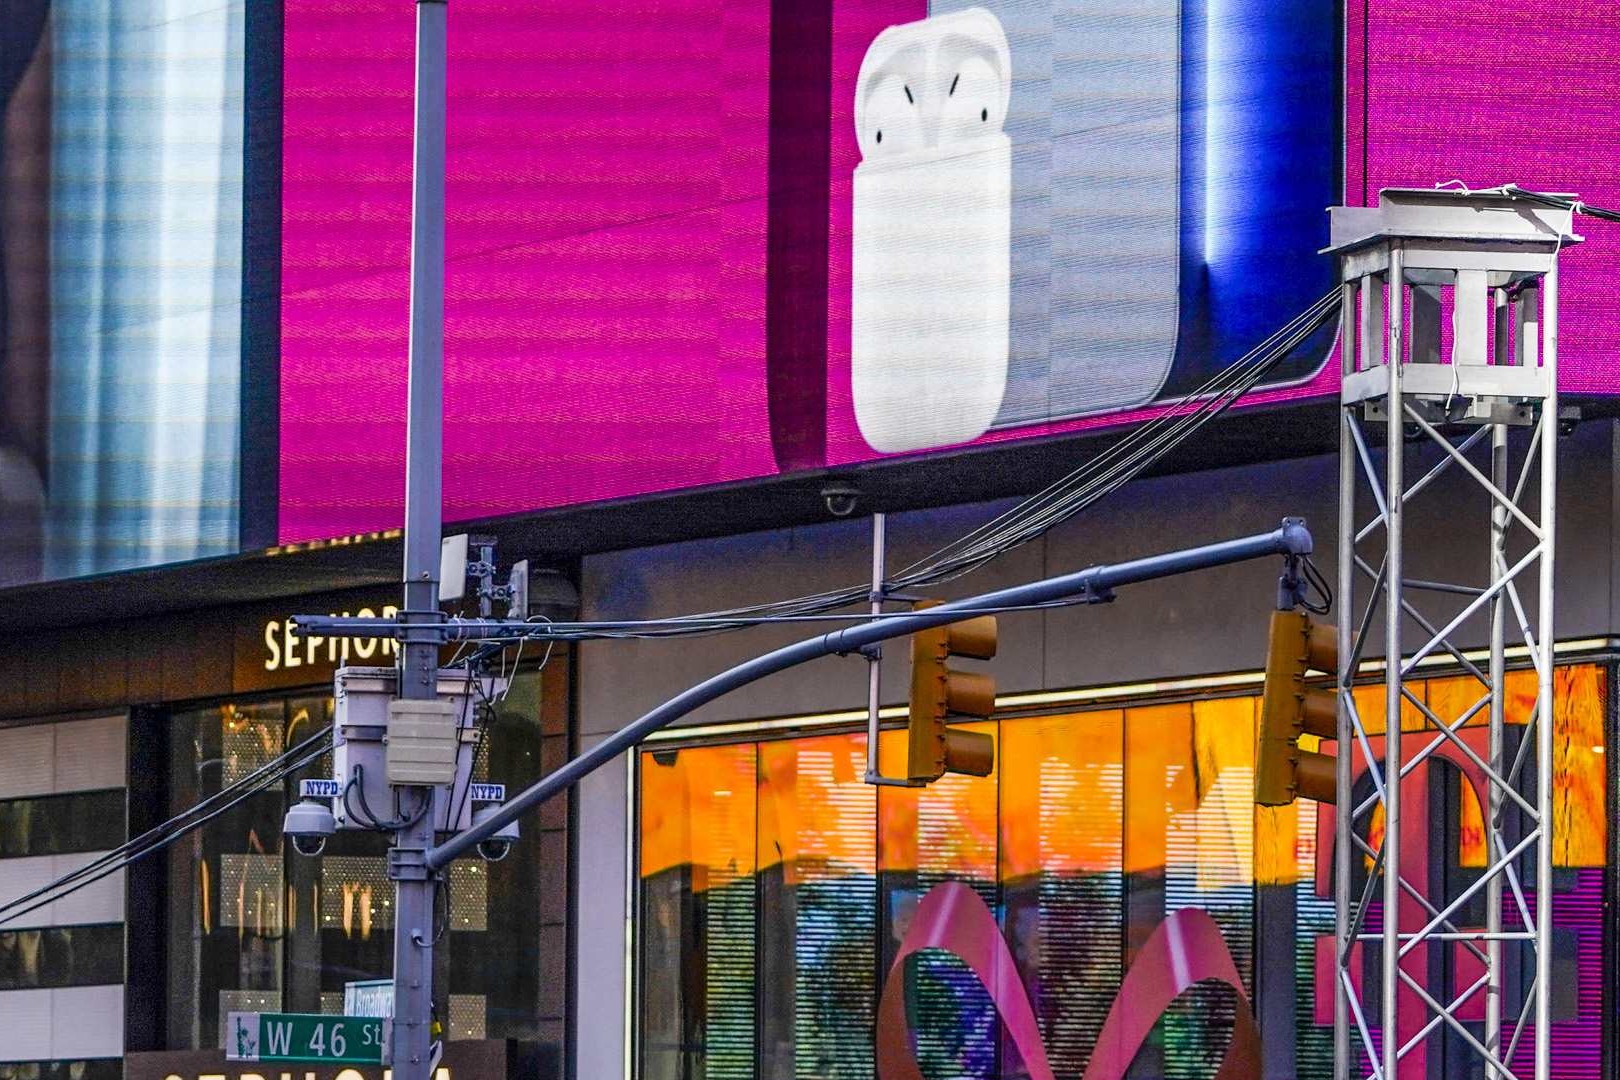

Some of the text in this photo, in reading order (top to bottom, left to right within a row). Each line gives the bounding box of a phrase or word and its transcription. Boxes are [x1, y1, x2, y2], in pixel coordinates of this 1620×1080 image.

[265, 606, 400, 671] SEPHOR
[305, 780, 338, 796] NYPD
[470, 785, 503, 800] NYPD
[356, 986, 393, 1017] Broadwa
[267, 1021, 381, 1057] W 46 St
